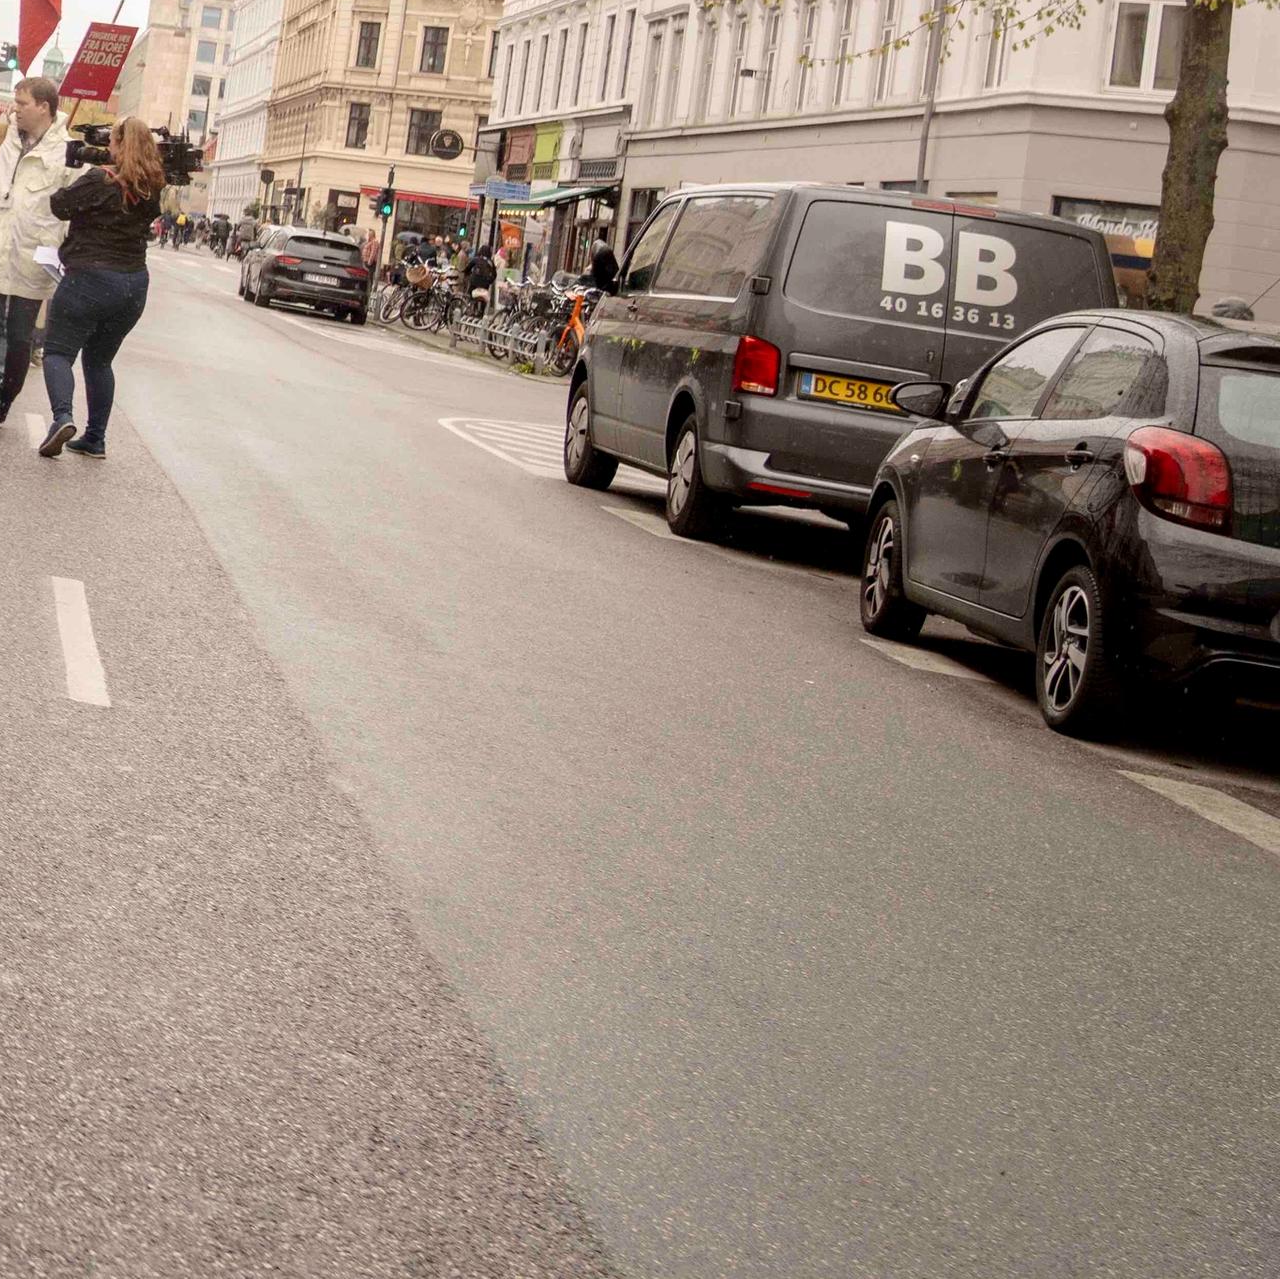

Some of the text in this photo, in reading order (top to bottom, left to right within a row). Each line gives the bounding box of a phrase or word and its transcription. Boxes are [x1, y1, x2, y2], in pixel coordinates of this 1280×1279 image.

[78, 49, 123, 68] FRIDAG
[881, 221, 1018, 307] BB
[880, 295, 1015, 330] 40 16 36 13
[814, 377, 841, 396] DC
[845, 382, 868, 401] 58
